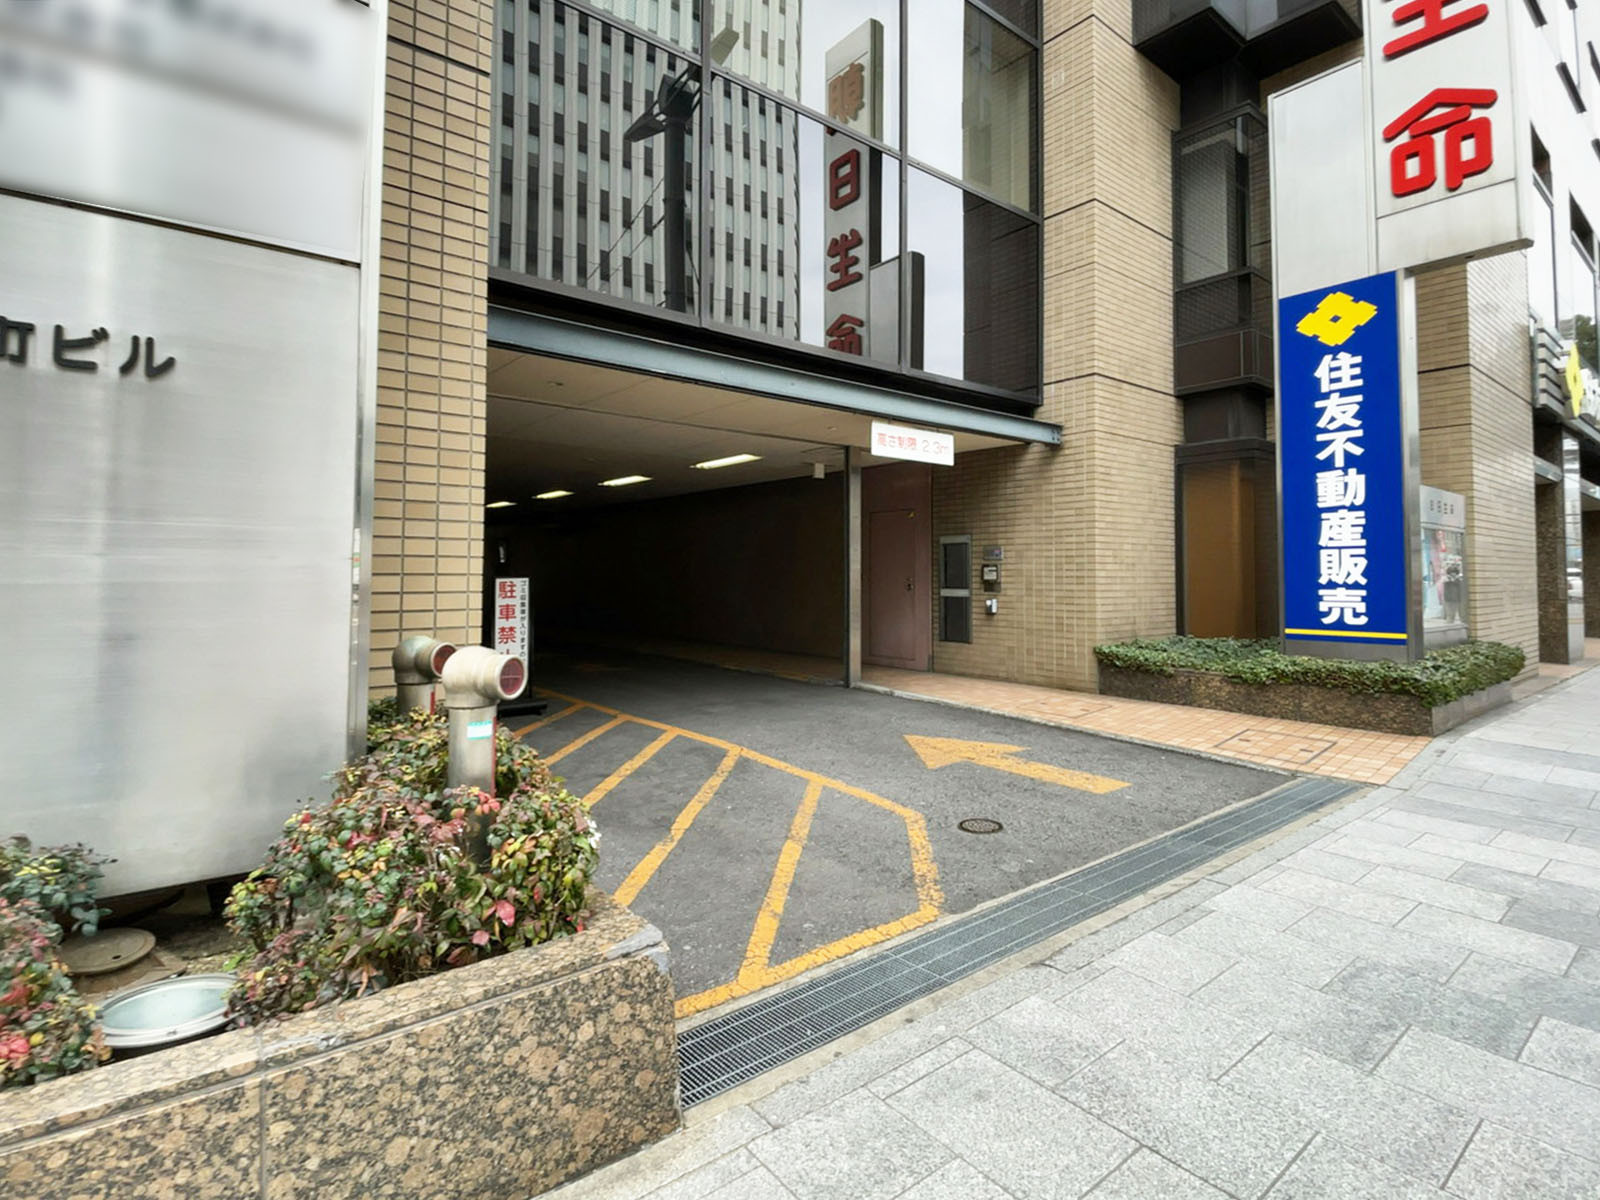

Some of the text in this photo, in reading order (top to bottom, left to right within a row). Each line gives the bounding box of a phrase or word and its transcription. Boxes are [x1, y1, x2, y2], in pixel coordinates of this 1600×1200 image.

[1314, 352, 1368, 625] 住友不動産販売
